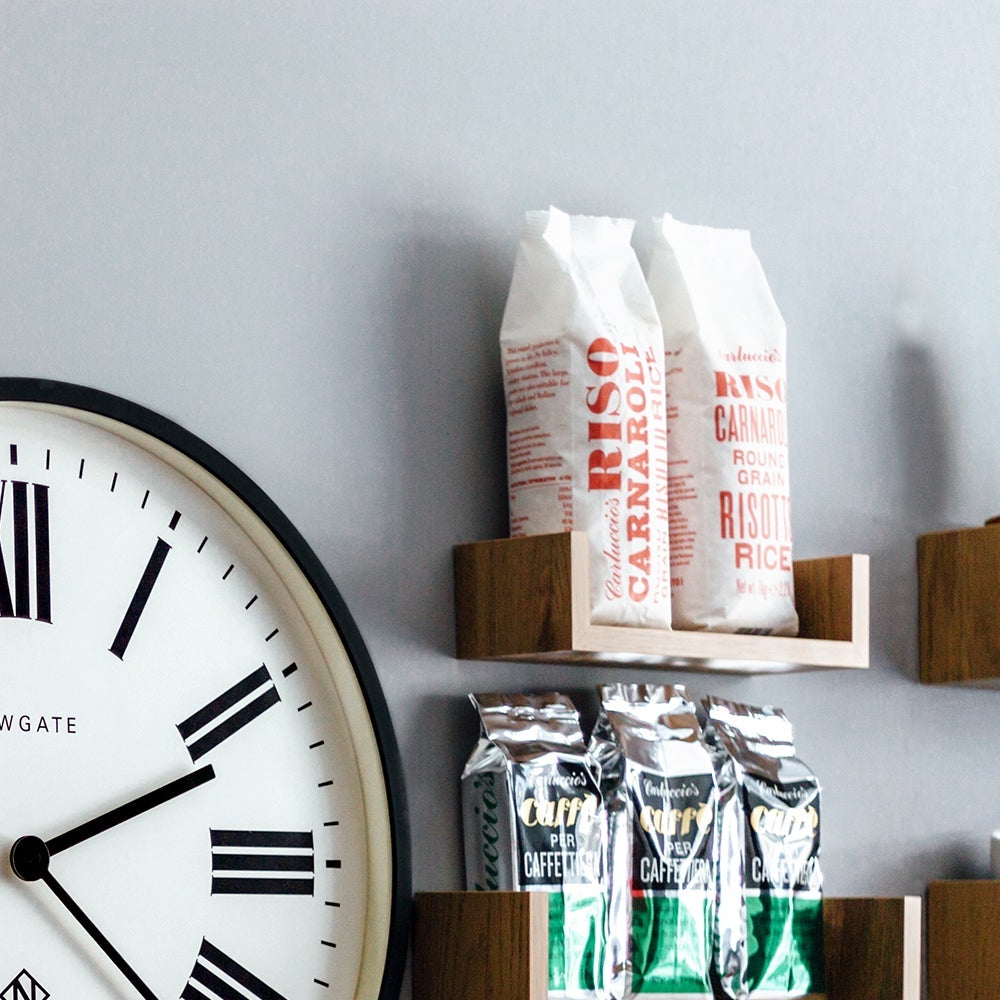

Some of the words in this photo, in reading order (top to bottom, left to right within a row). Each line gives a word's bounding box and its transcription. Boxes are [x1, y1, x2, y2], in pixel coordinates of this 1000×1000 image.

[586, 337, 623, 492] RISO
[714, 404, 788, 448] CARNARO
[620, 341, 651, 603] CARNAROLI
[604, 496, 623, 601] Carluccio's
[735, 542, 791, 571] RICE
[475, 771, 500, 891] uccio's
[550, 833, 576, 849] PER
[669, 841, 692, 857] PER
